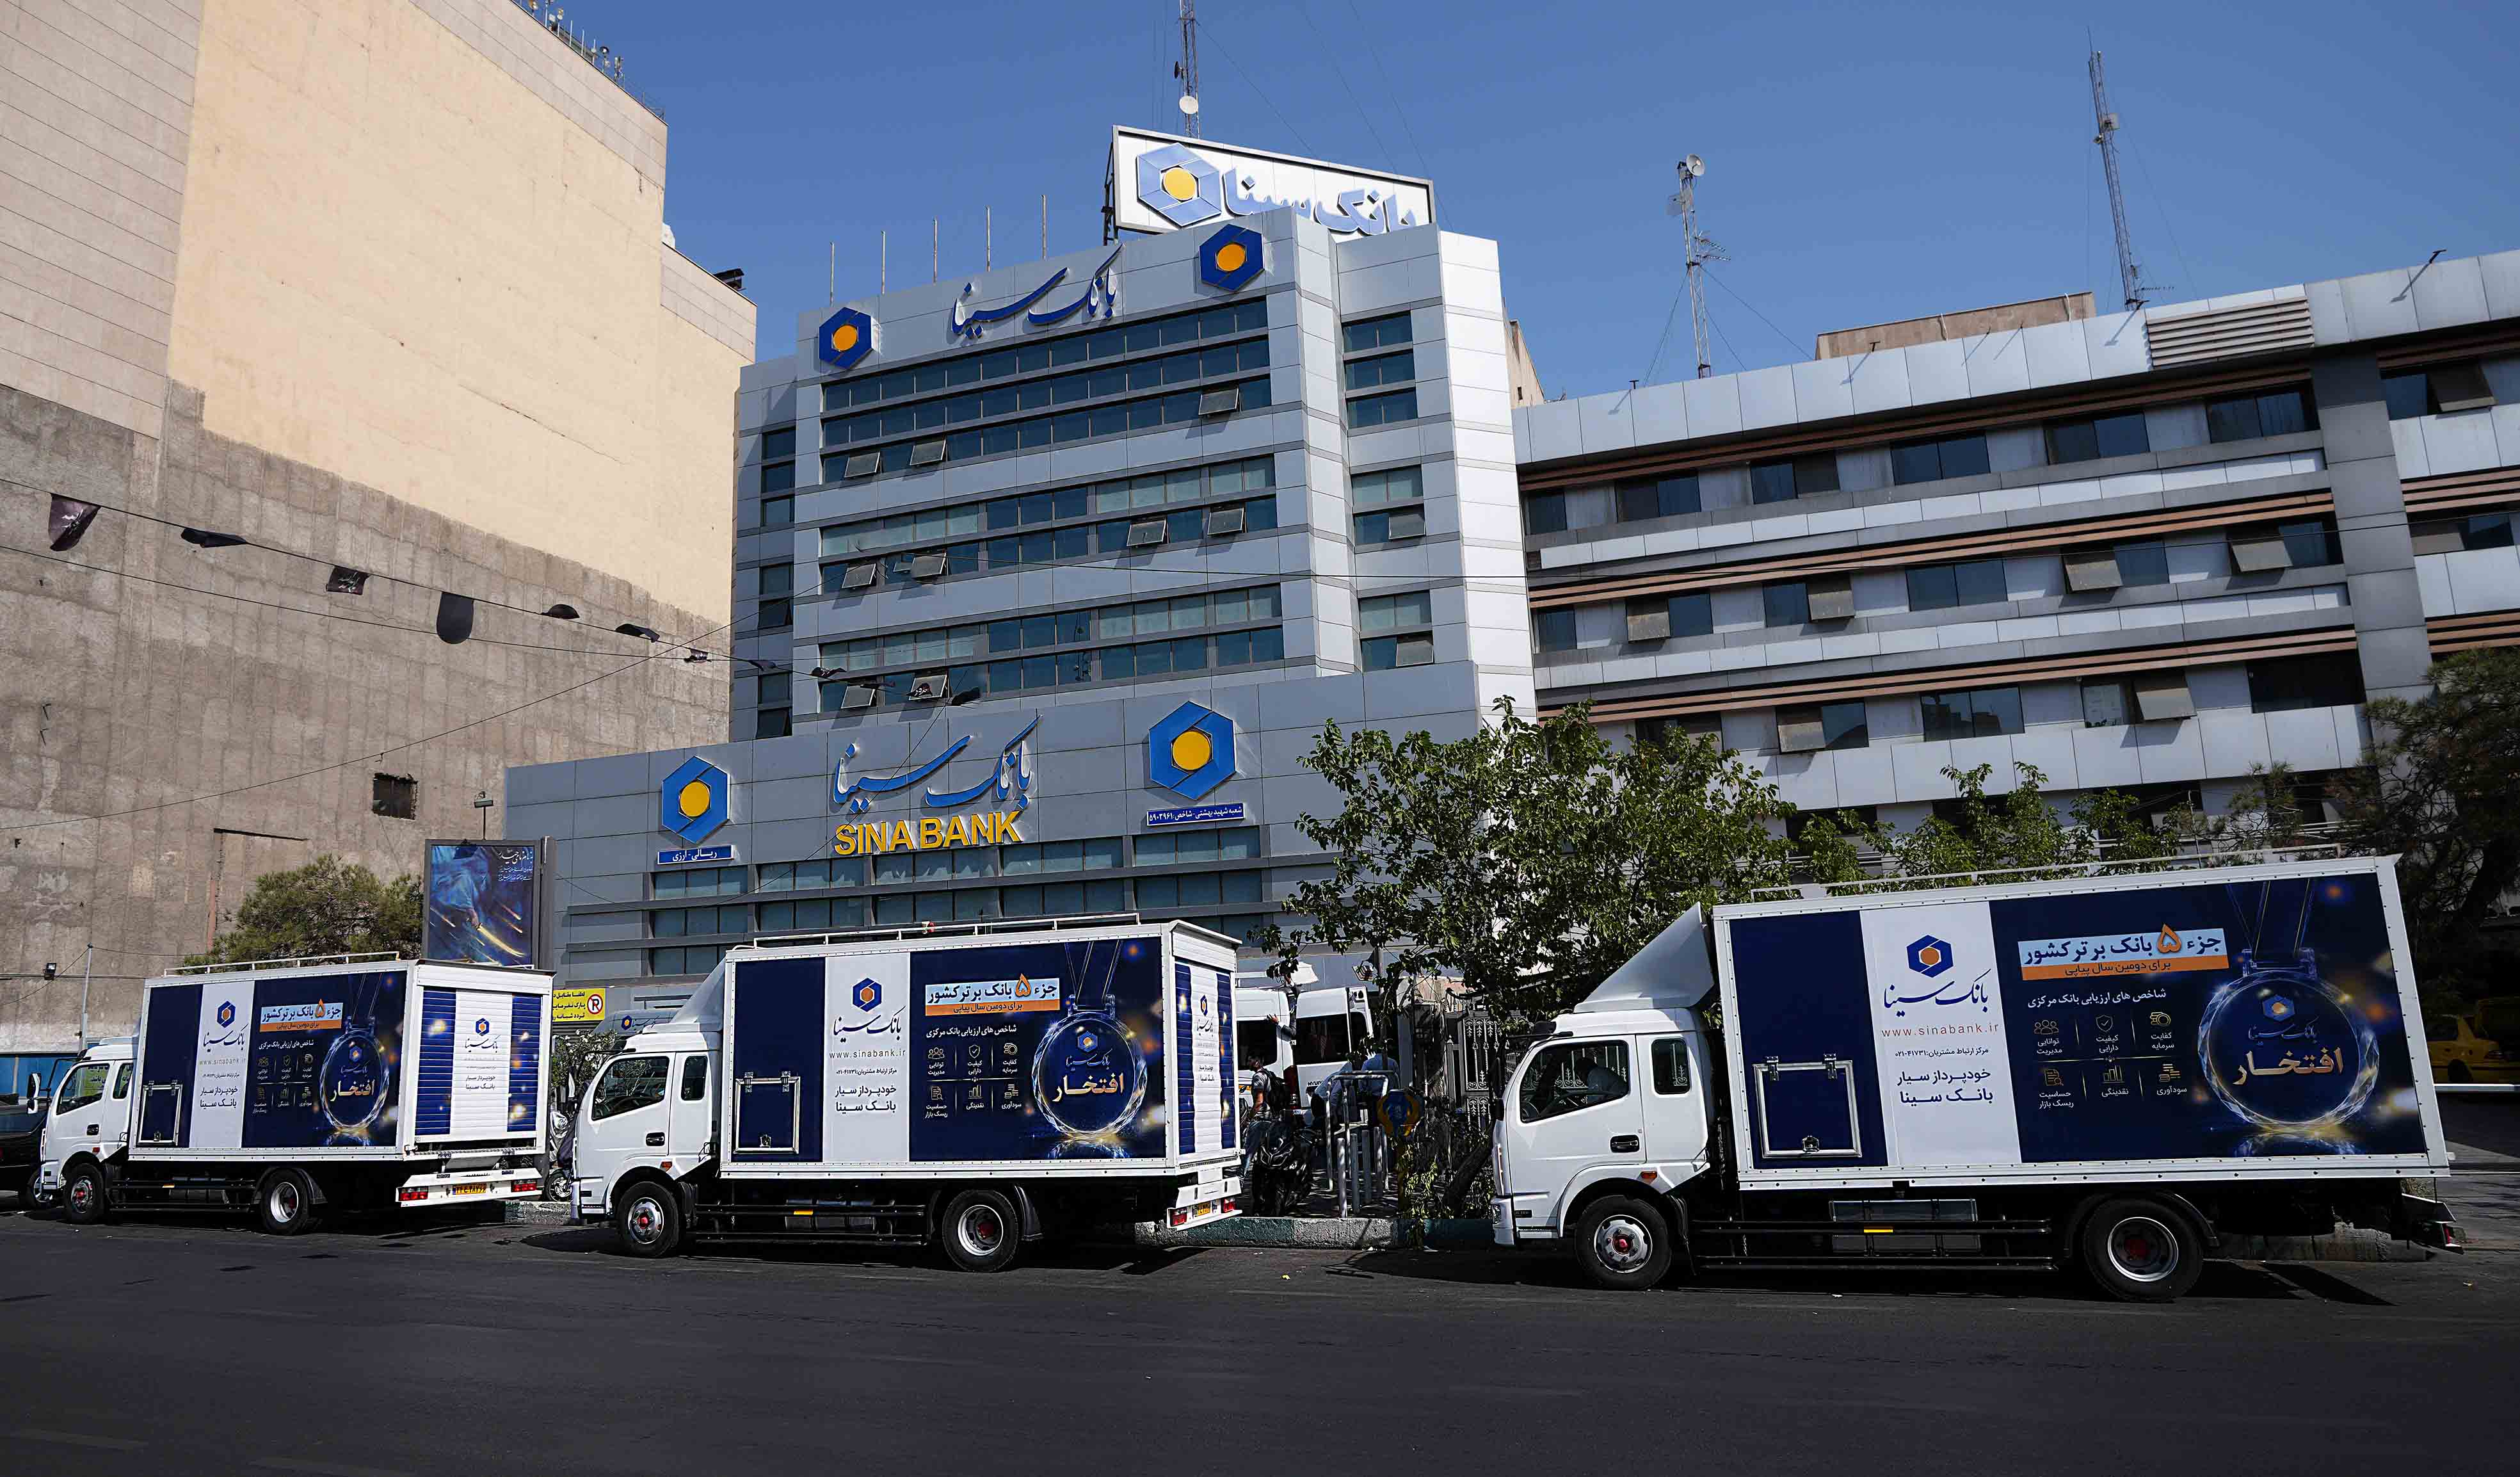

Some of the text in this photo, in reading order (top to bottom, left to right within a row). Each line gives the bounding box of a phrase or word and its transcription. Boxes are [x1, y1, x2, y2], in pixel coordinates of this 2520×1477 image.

[952, 243, 1124, 339] بانک سینا
[833, 714, 1043, 814] بانک سینا
[1214, 807, 1228, 816] شهید
[834, 811, 1025, 856] SINA BANK
[2156, 923, 2181, 953] ۵
[2187, 935, 2221, 954] جزء
[2110, 935, 2152, 955] بانک
[2025, 940, 2071, 964] کشور
[2064, 960, 2171, 976] برای دومین سال پیاپی
[984, 983, 1012, 999] بانک
[1015, 973, 1031, 997] ۵
[1034, 983, 1057, 998] جزء
[927, 985, 959, 1003] کشور
[1884, 969, 1991, 1017] بانک سینا
[2059, 994, 2080, 1005] بانک
[2081, 992, 2110, 1005] ارزیابی
[2133, 989, 2167, 1003] شاخص
[315, 999, 325, 1019] ۵
[971, 1003, 985, 1012] سال
[986, 1003, 1006, 1012] دومین
[1008, 1003, 1023, 1011] برای
[2028, 996, 2057, 1009] مرکزی
[262, 1008, 282, 1022] کشور
[297, 1006, 314, 1017] بانک
[326, 1006, 341, 1019] جزء
[833, 1006, 906, 1043] بانک سینا
[994, 1024, 1016, 1035] شاخص
[1881, 1022, 1999, 1037] www.sinabank.ir
[203, 1024, 248, 1053] بانک سینا
[926, 1028, 945, 1038] مرکزی
[947, 1028, 960, 1036] بانک
[961, 1027, 981, 1037] ارزیابی
[2037, 1038, 2059, 1046] توانایی
[2099, 1044, 2119, 1053] دارایی
[829, 1049, 906, 1059] www.sinabank.ir
[1975, 1047, 1989, 1055] مرکز
[2233, 1046, 2344, 1085] افتخار
[1897, 1069, 1991, 1086] خودپرداز سیار
[200, 1086, 237, 1096] خودپرداز سیار
[330, 1079, 375, 1101] افتخار
[835, 1085, 897, 1097] خودپرداز سیار
[1052, 1072, 1124, 1101] افتخار
[2101, 1088, 2129, 1097] نقدینگی
[2156, 1086, 2187, 1095] سودآوری
[1900, 1088, 1993, 1106] بانک سینا
[200, 1099, 237, 1110] بانک سینا
[836, 1101, 896, 1114] بانک سینا
[2039, 1101, 2053, 1109] بازار
